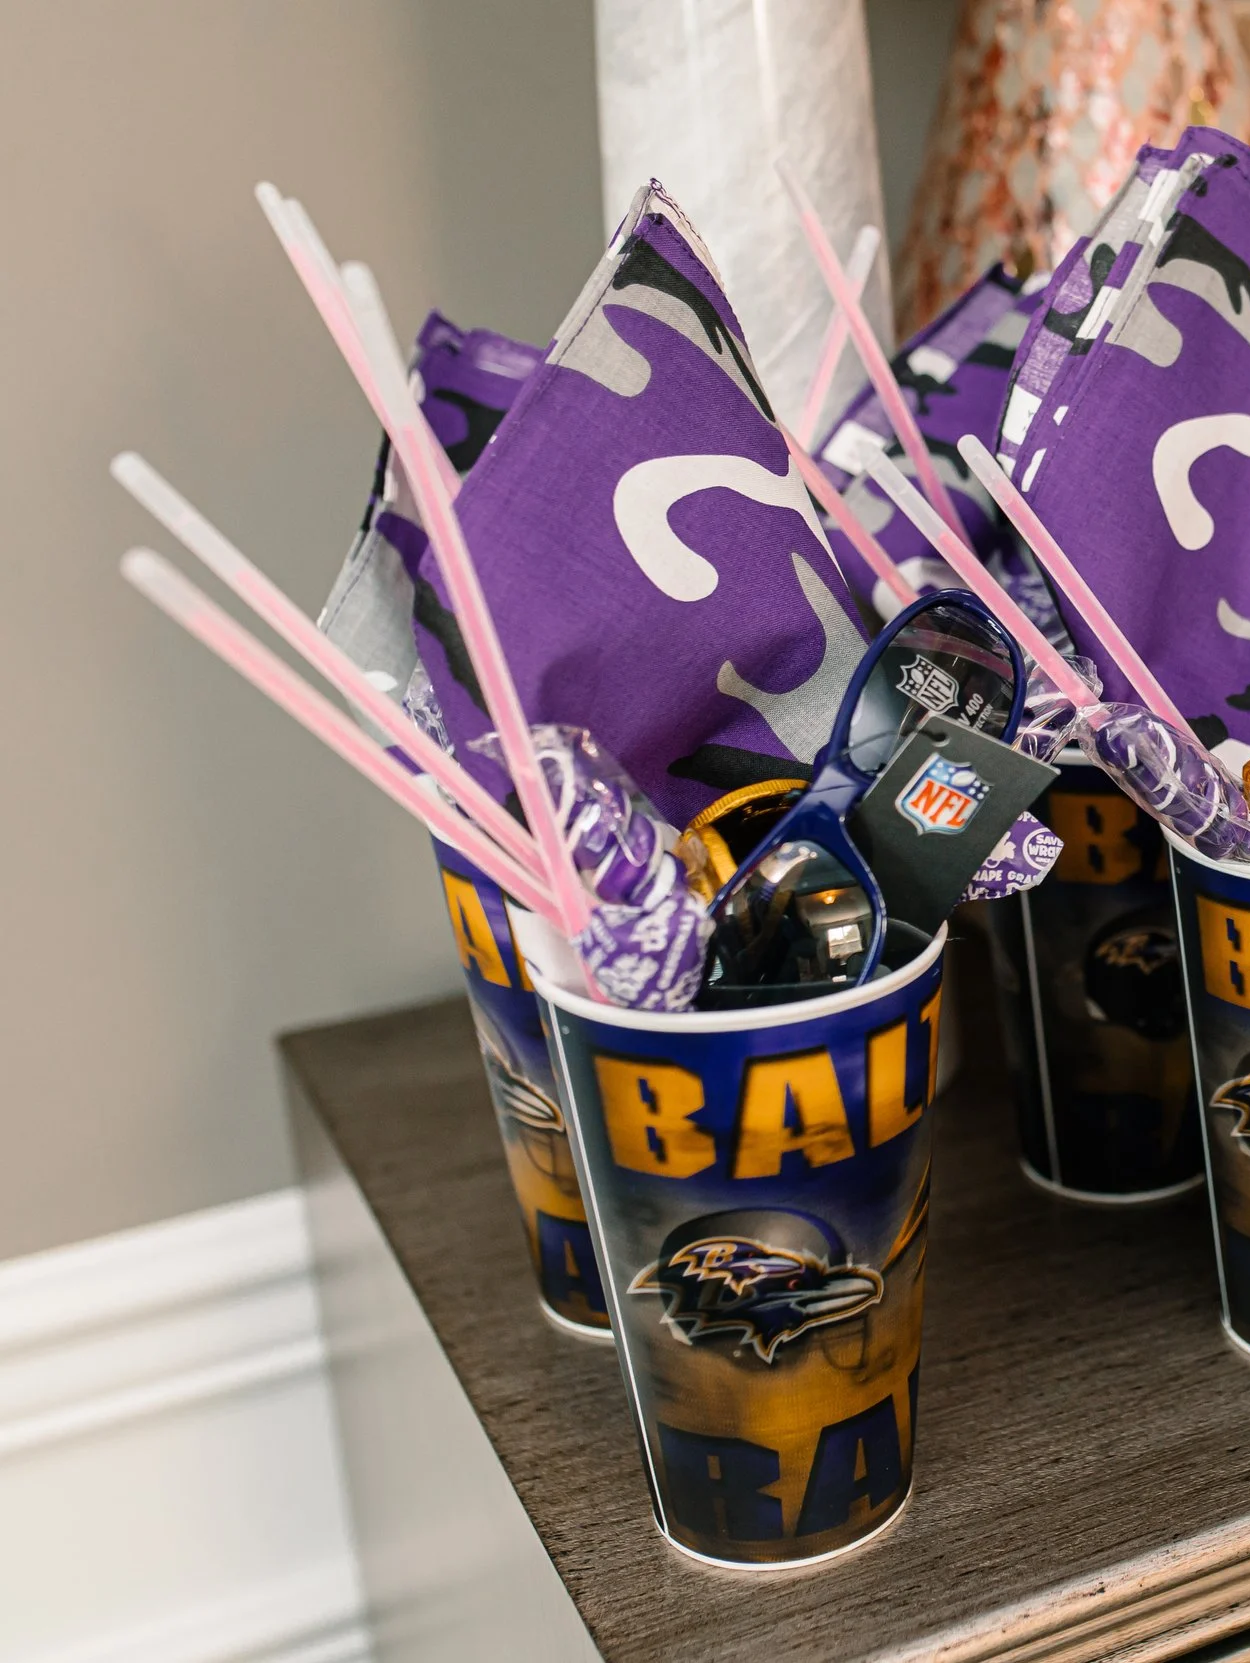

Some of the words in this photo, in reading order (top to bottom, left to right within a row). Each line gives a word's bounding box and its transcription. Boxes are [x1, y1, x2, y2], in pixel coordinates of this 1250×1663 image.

[919, 671, 952, 710] NFL
[965, 693, 984, 717] 400
[972, 703, 994, 731] TECTION
[910, 779, 973, 829] NFL
[972, 870, 1004, 882] APE
[1007, 871, 1039, 885] GRA
[657, 1358, 919, 1540] RA
